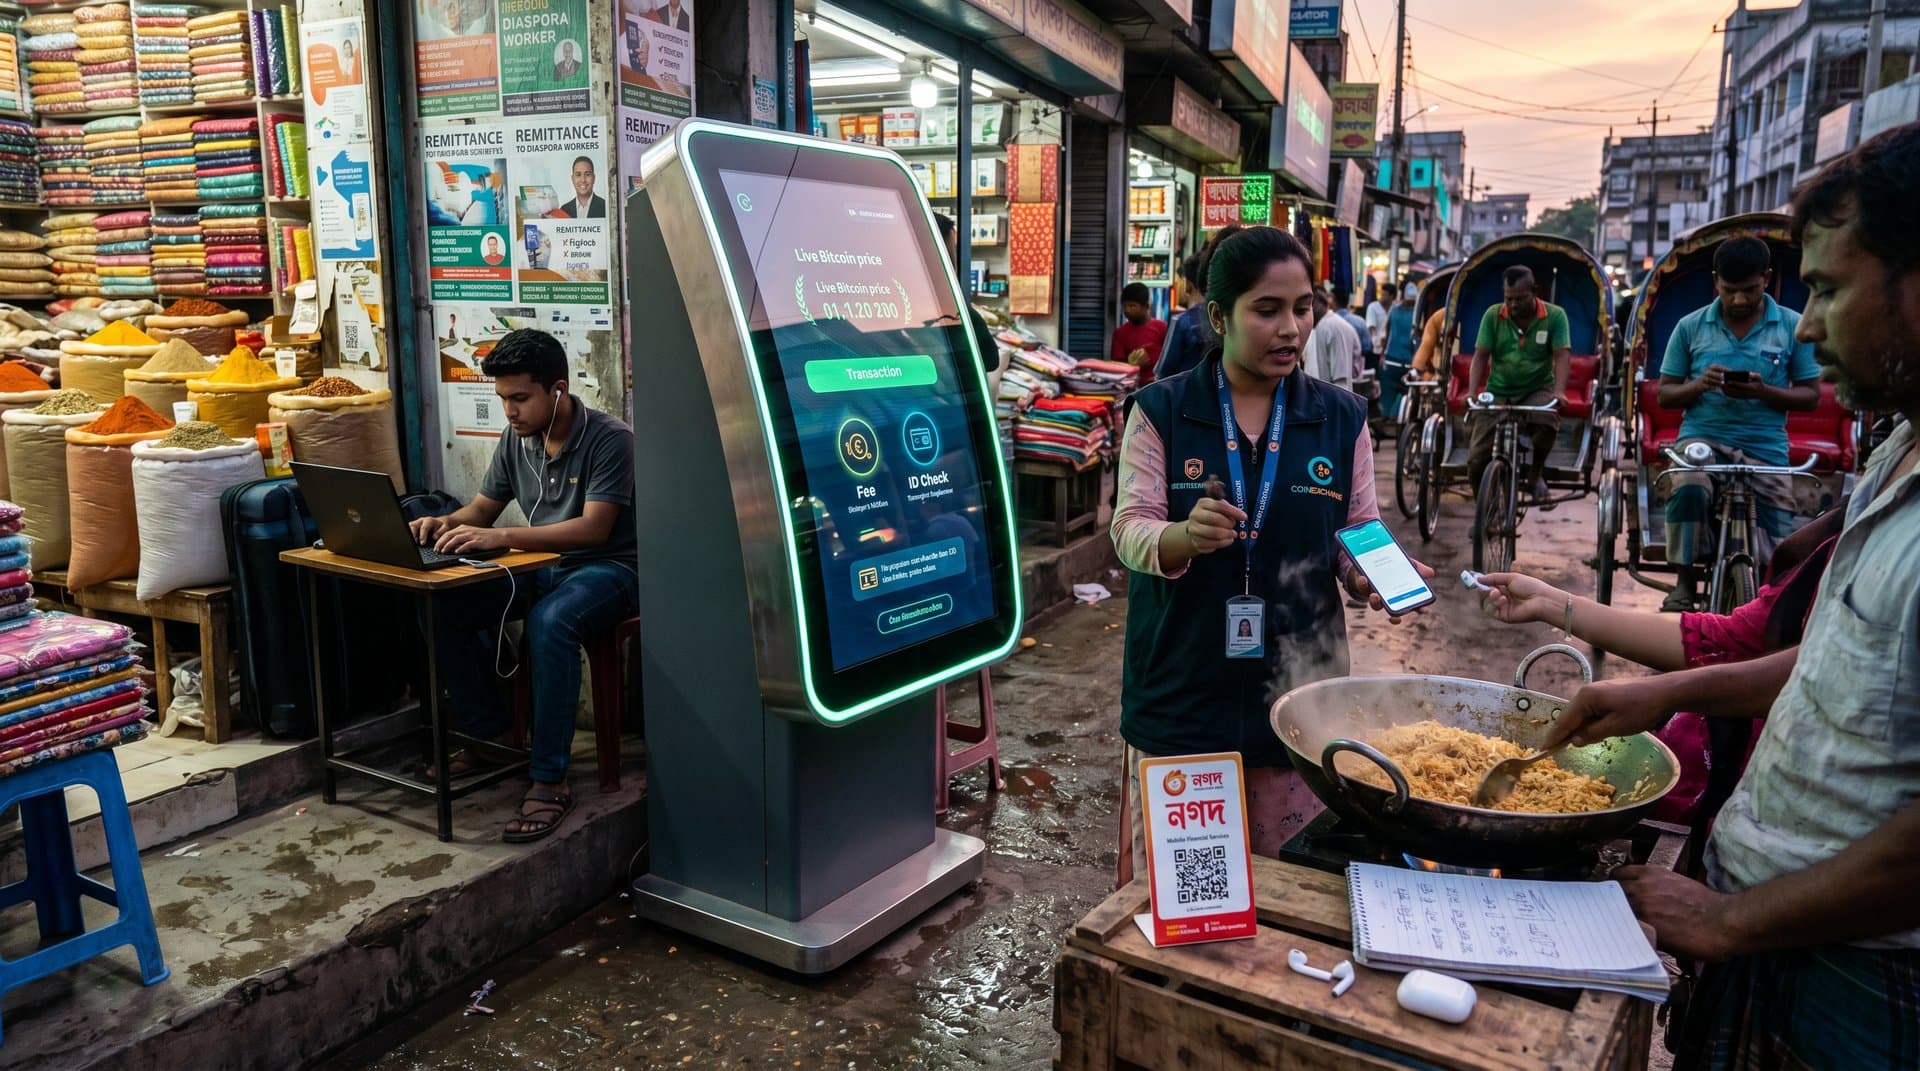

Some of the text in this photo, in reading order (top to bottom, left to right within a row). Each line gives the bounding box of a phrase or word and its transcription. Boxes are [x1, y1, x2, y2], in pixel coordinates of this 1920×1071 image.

[502, 12, 569, 30] DIASPORA
[503, 30, 556, 47] WORKER
[425, 131, 503, 148] REMITTANCE
[516, 125, 599, 142] REMITTANCE
[625, 134, 635, 143] TO
[517, 141, 600, 153] TO DIASPORA WORKERS
[794, 248, 883, 268] Live Bitcoin price
[815, 281, 891, 297] Live Bitcoin price
[846, 366, 902, 381] Transaction
[908, 471, 949, 489] ID Check
[856, 485, 876, 499] Fee
[1191, 772, 1223, 787] নগদ
[1165, 799, 1226, 830] নগদ
